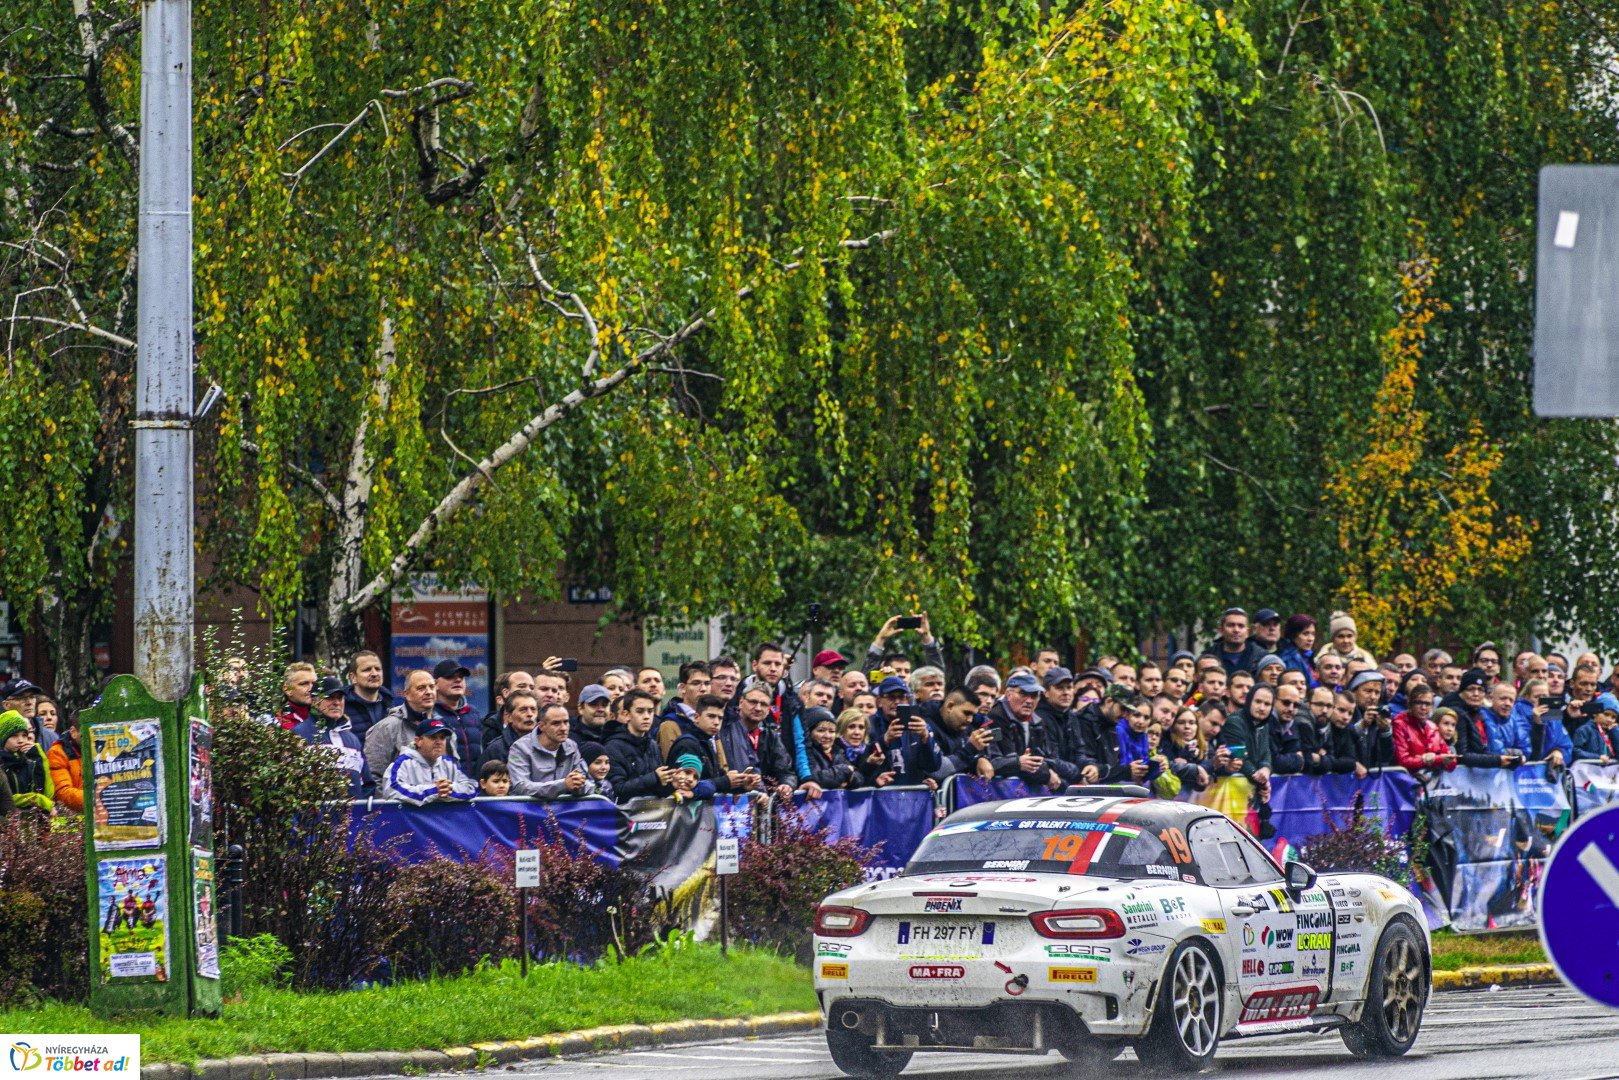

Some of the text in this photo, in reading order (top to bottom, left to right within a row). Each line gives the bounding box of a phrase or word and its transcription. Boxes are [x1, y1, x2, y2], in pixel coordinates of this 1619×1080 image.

[1018, 821, 1036, 829] GOT
[1036, 821, 1071, 829] TALENT?
[1070, 822, 1097, 830] PROVE
[1095, 823, 1110, 831] IT!
[1041, 834, 1085, 861] 19
[1158, 827, 1192, 864] 19
[983, 860, 1030, 869] BERNINI
[1146, 865, 1179, 877] BERNINI
[925, 899, 963, 912] PHOENIX
[1121, 900, 1154, 915] Sandrini
[1126, 913, 1158, 924] METALLI
[1166, 913, 1191, 921] EUROPE
[913, 927, 930, 939] FH
[934, 927, 956, 939] 297
[960, 927, 976, 939] FY
[1275, 928, 1293, 942] WOW
[1297, 933, 1332, 951] LORAN
[822, 966, 845, 976] PIRELLI
[1052, 969, 1093, 980] PIRELLI
